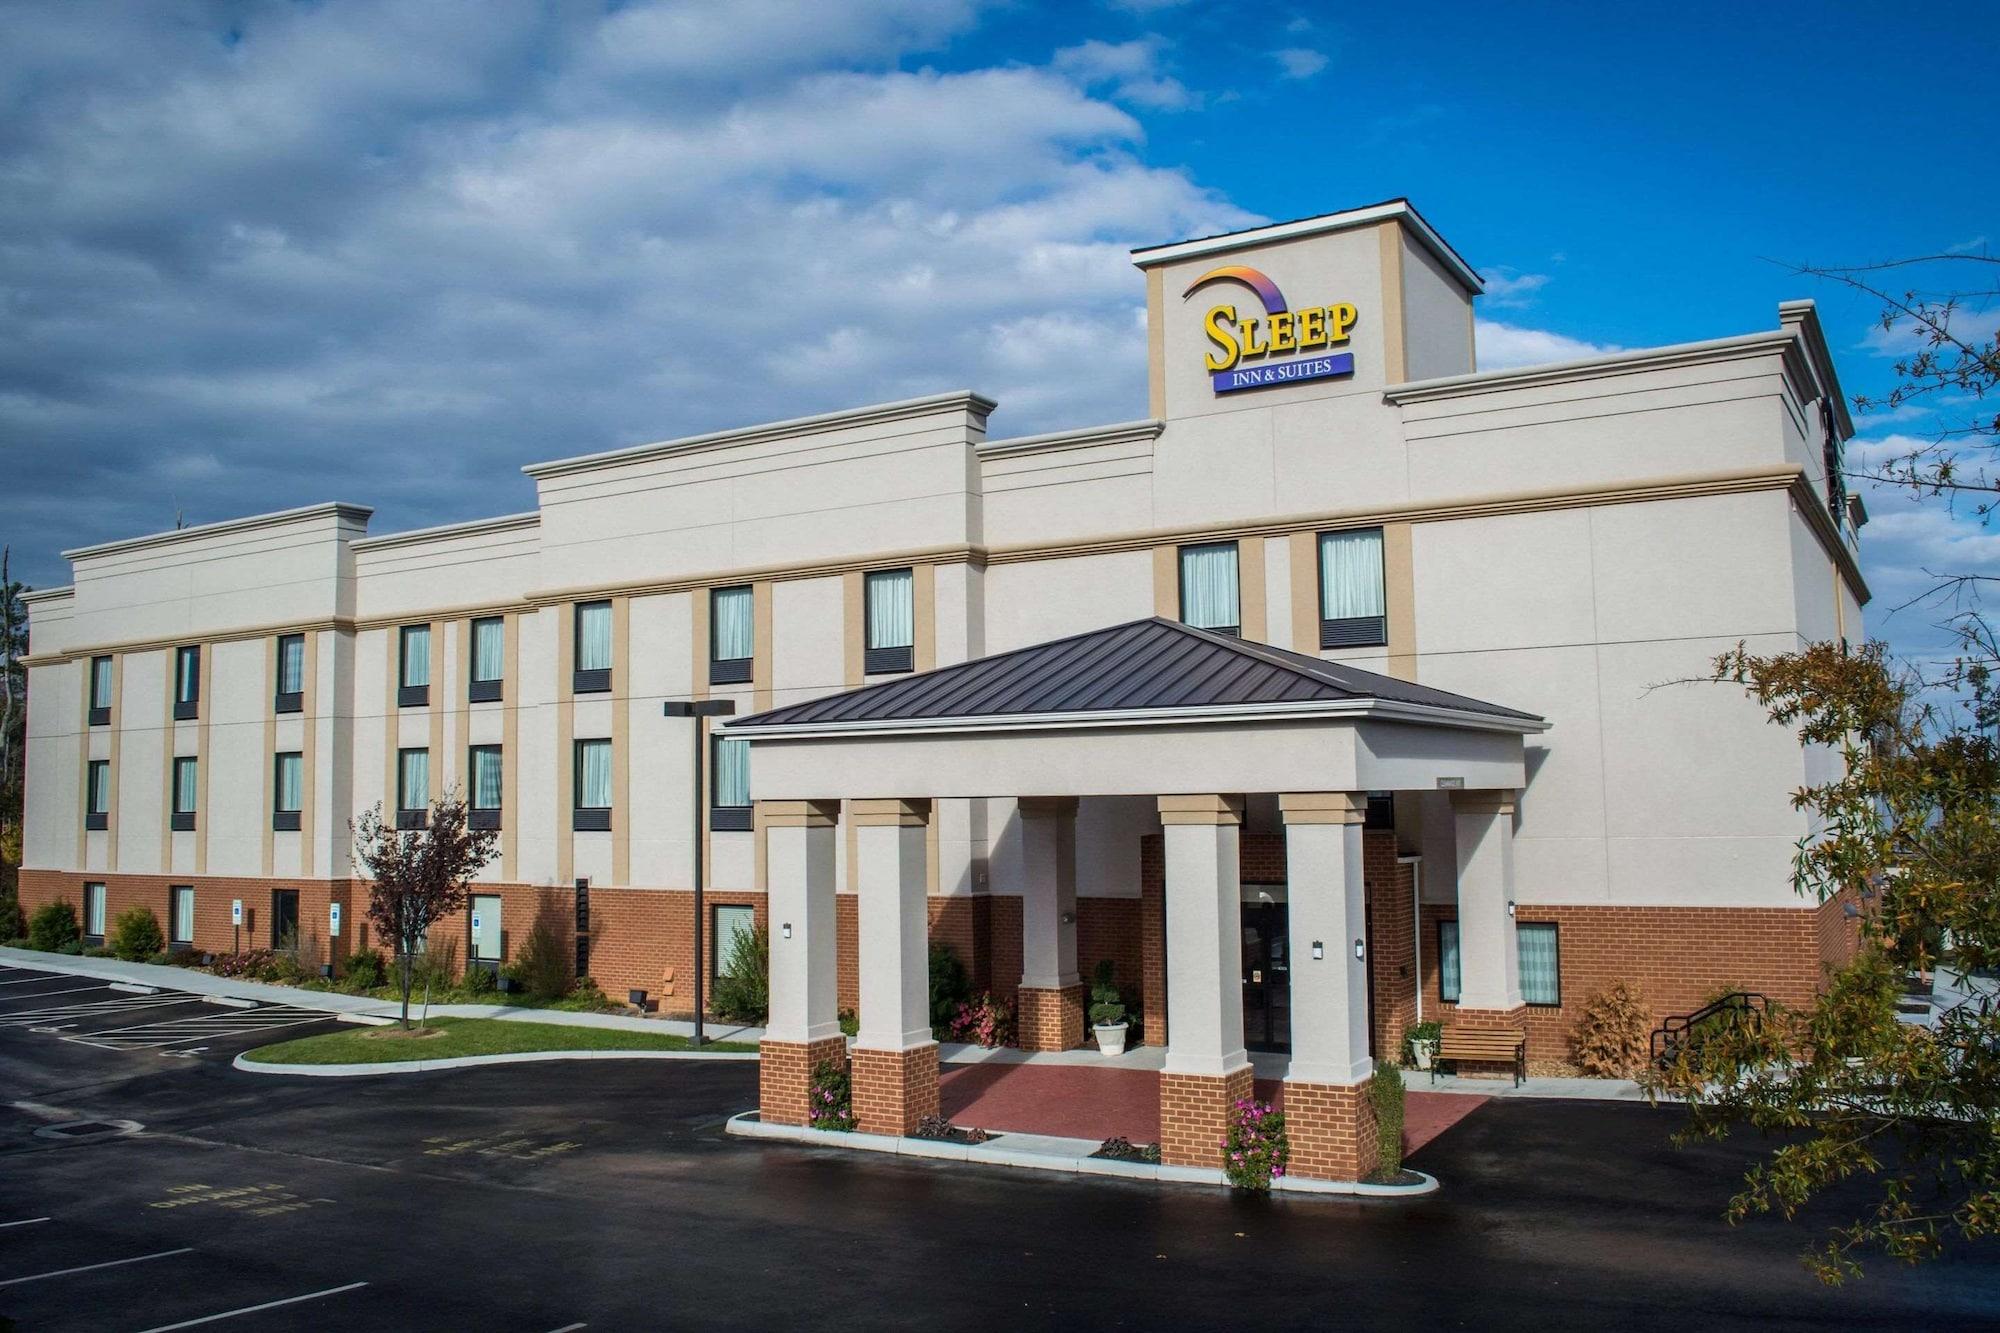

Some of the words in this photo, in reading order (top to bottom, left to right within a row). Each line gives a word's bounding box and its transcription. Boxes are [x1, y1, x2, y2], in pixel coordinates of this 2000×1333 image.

[1204, 303, 1357, 371] SLEEP
[1233, 369, 1262, 386] INN
[1264, 368, 1275, 382] &
[1278, 359, 1332, 379] SUITES
